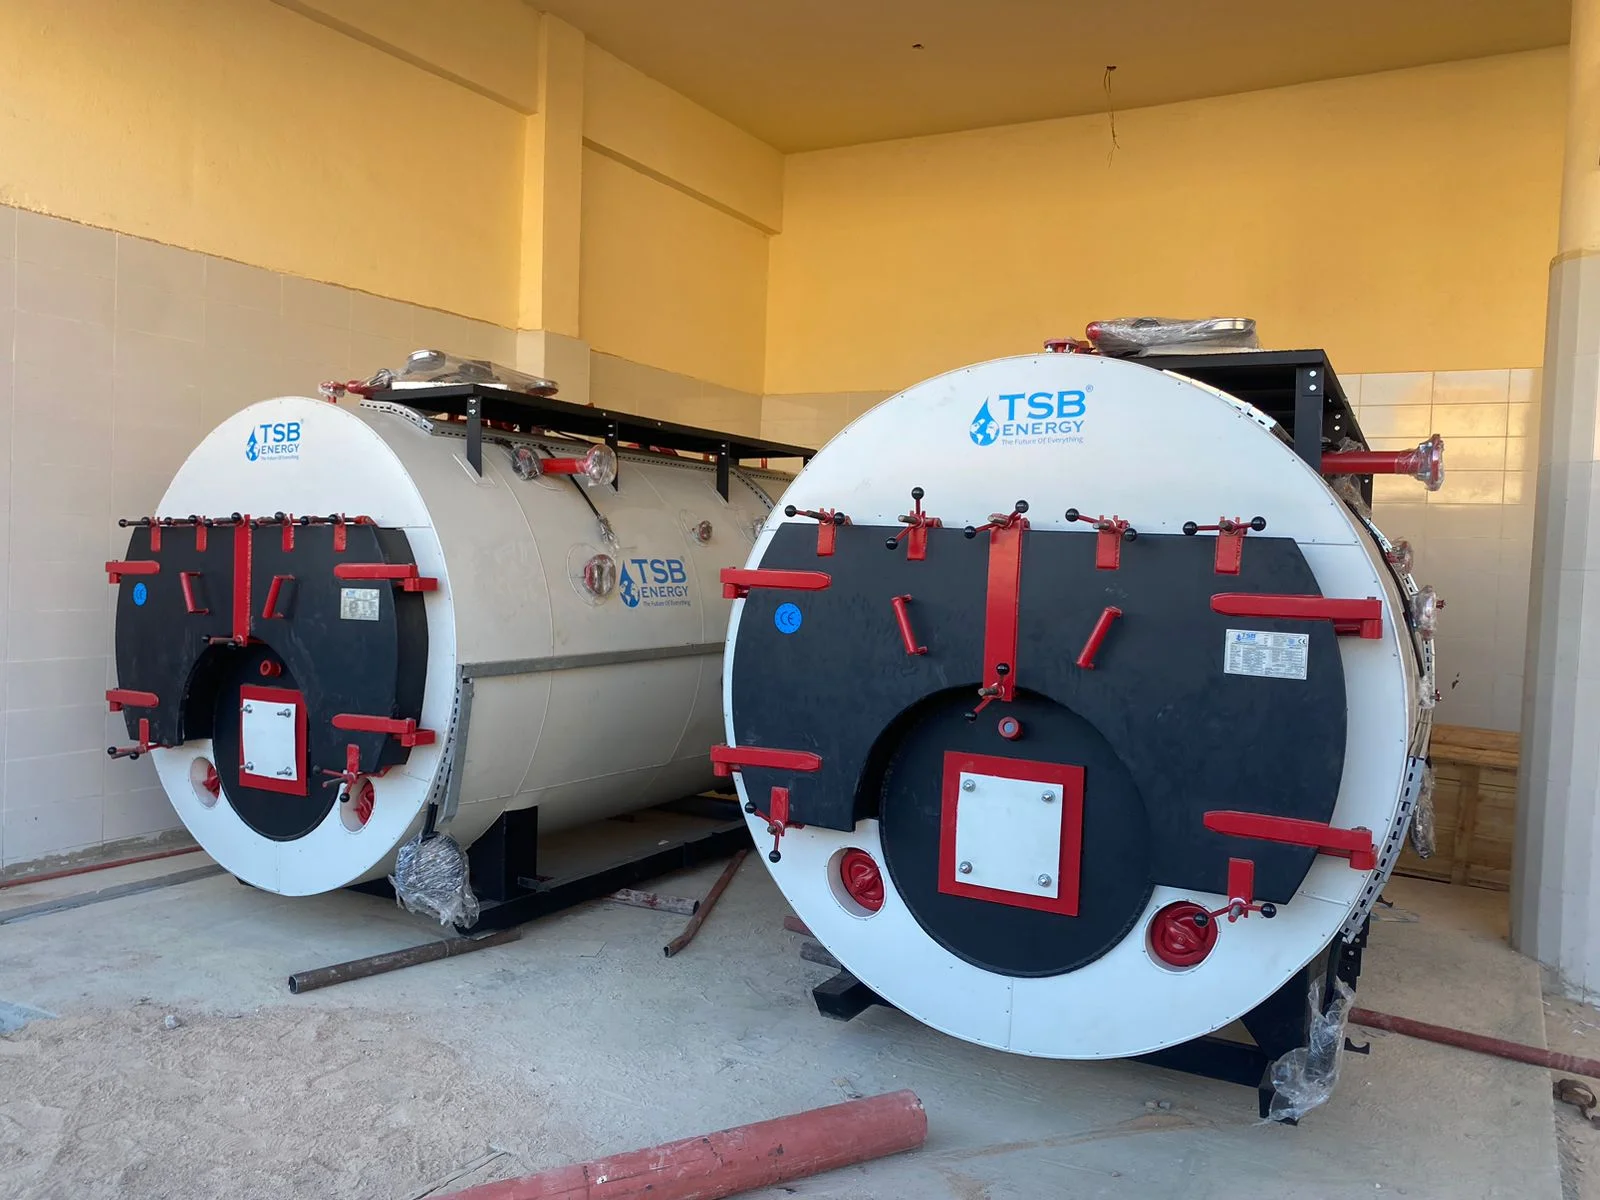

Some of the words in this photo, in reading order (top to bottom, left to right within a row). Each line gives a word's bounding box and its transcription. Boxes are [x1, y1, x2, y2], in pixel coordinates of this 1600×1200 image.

[998, 390, 1086, 421] TSB
[260, 422, 301, 443] TSB
[1002, 420, 1084, 436] ENERGY
[261, 443, 300, 455] ENERGY
[1002, 438, 1013, 446] The
[1015, 437, 1036, 446] Future
[630, 559, 687, 584] TSB
[641, 586, 689, 598] ENERGY
